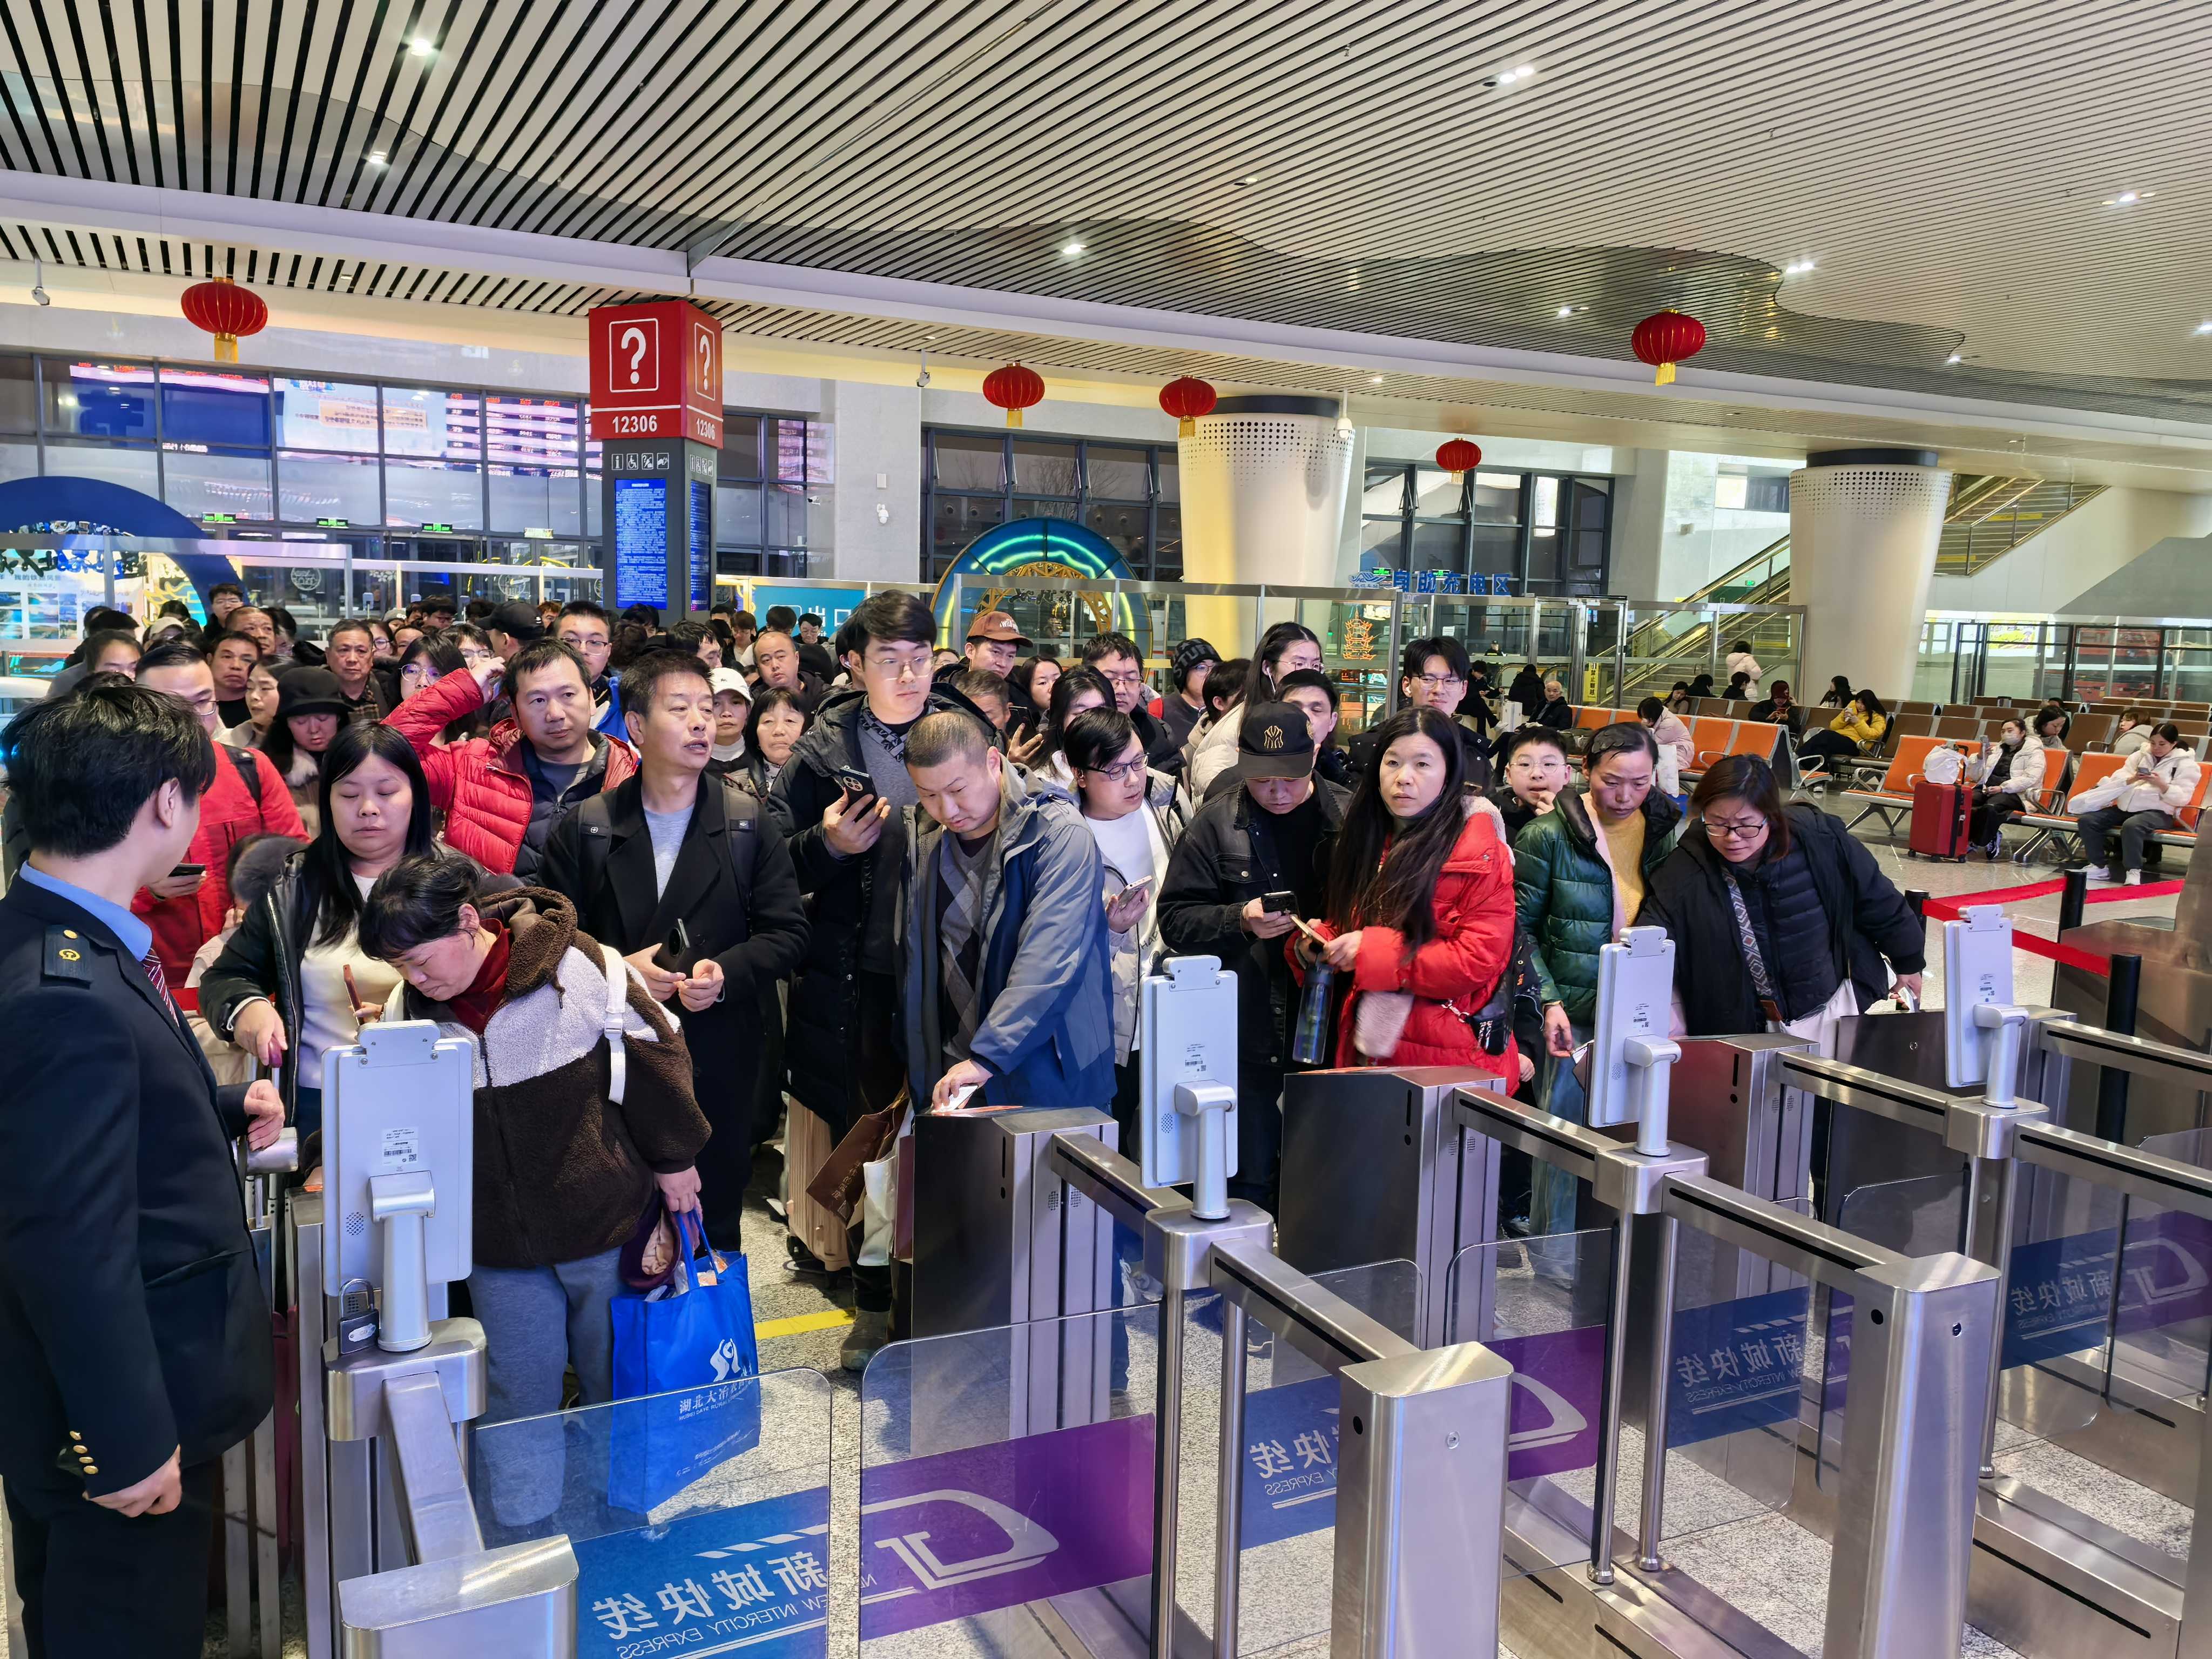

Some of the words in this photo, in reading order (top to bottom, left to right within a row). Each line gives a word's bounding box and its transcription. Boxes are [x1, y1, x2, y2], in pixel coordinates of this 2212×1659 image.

[612, 415, 657, 433] 12306
[696, 418, 715, 440] 12306
[1393, 569, 1512, 595] 自助充电区
[808, 605, 851, 627] 出口
